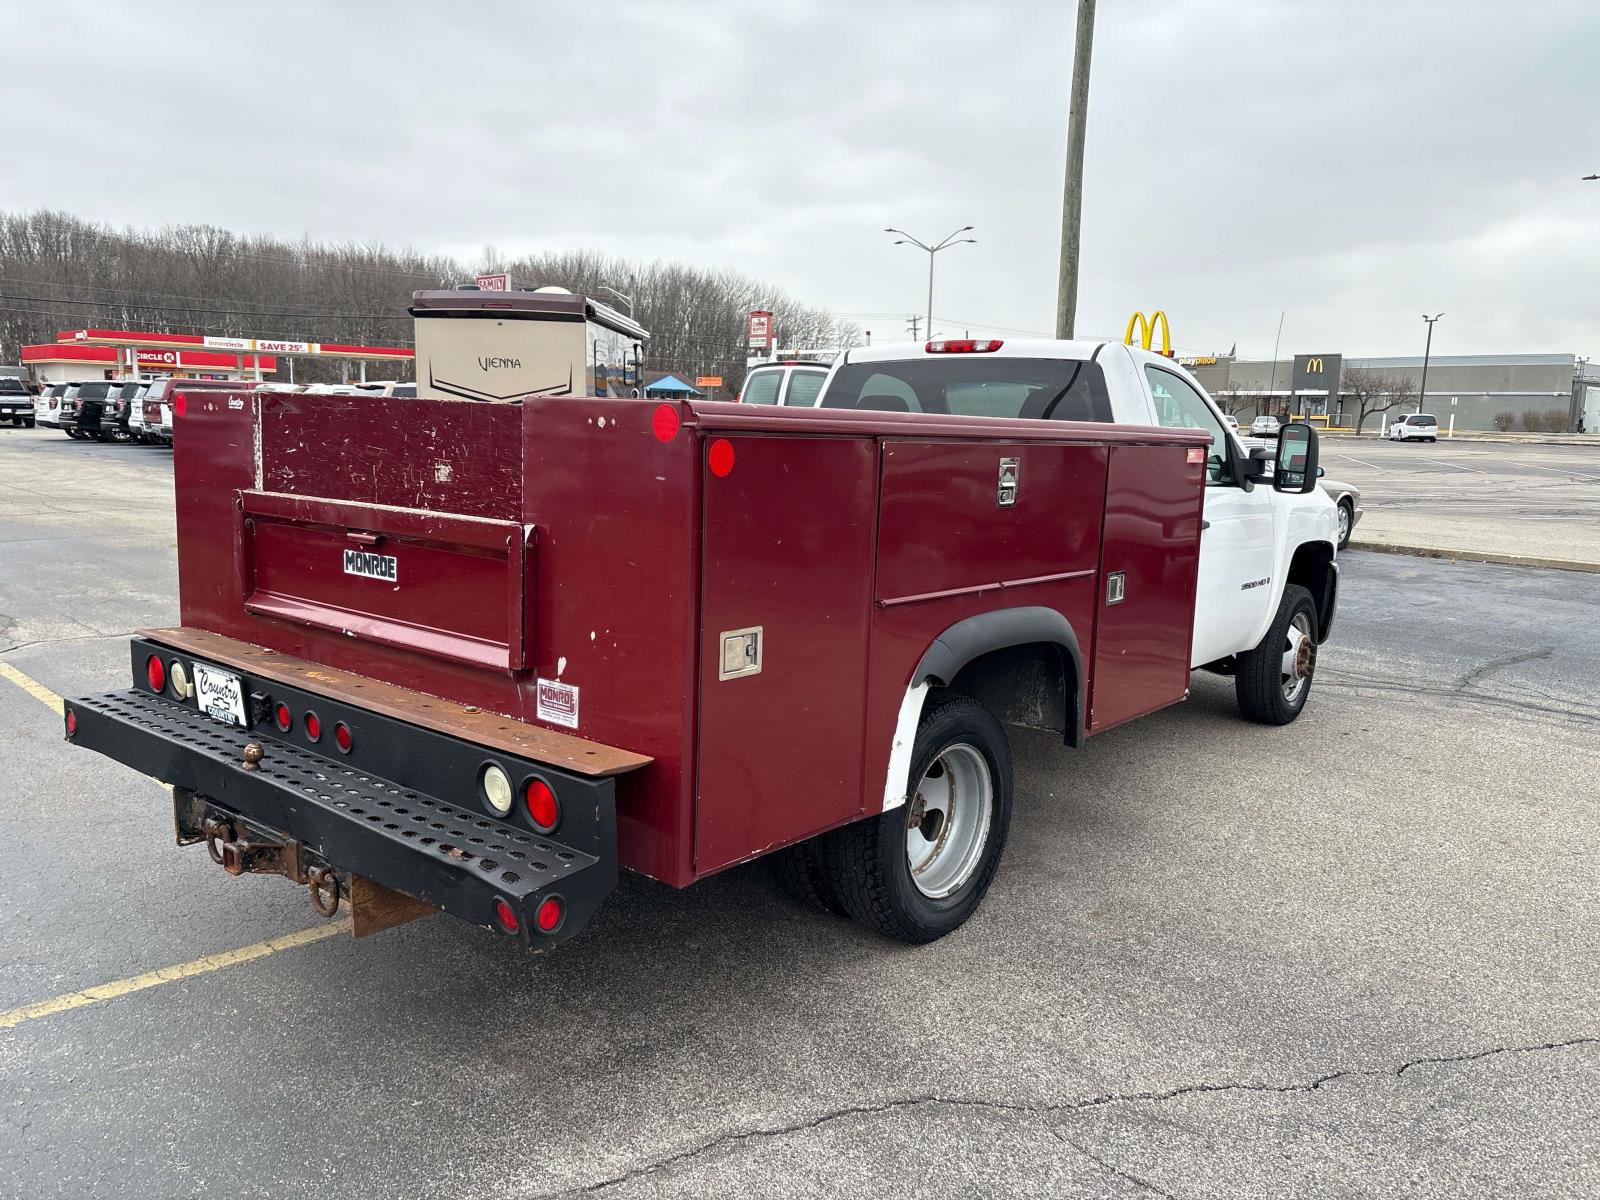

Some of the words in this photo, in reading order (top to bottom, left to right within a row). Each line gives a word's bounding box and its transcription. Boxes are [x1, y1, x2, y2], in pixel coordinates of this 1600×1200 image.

[260, 342, 287, 351] SAVE
[137, 352, 163, 361] CIRCLE
[478, 356, 522, 372] VIENNA
[1179, 357, 1217, 366] playplace
[345, 550, 396, 579] MONROE
[200, 671, 239, 708] Country
[540, 685, 575, 706] MONROE
